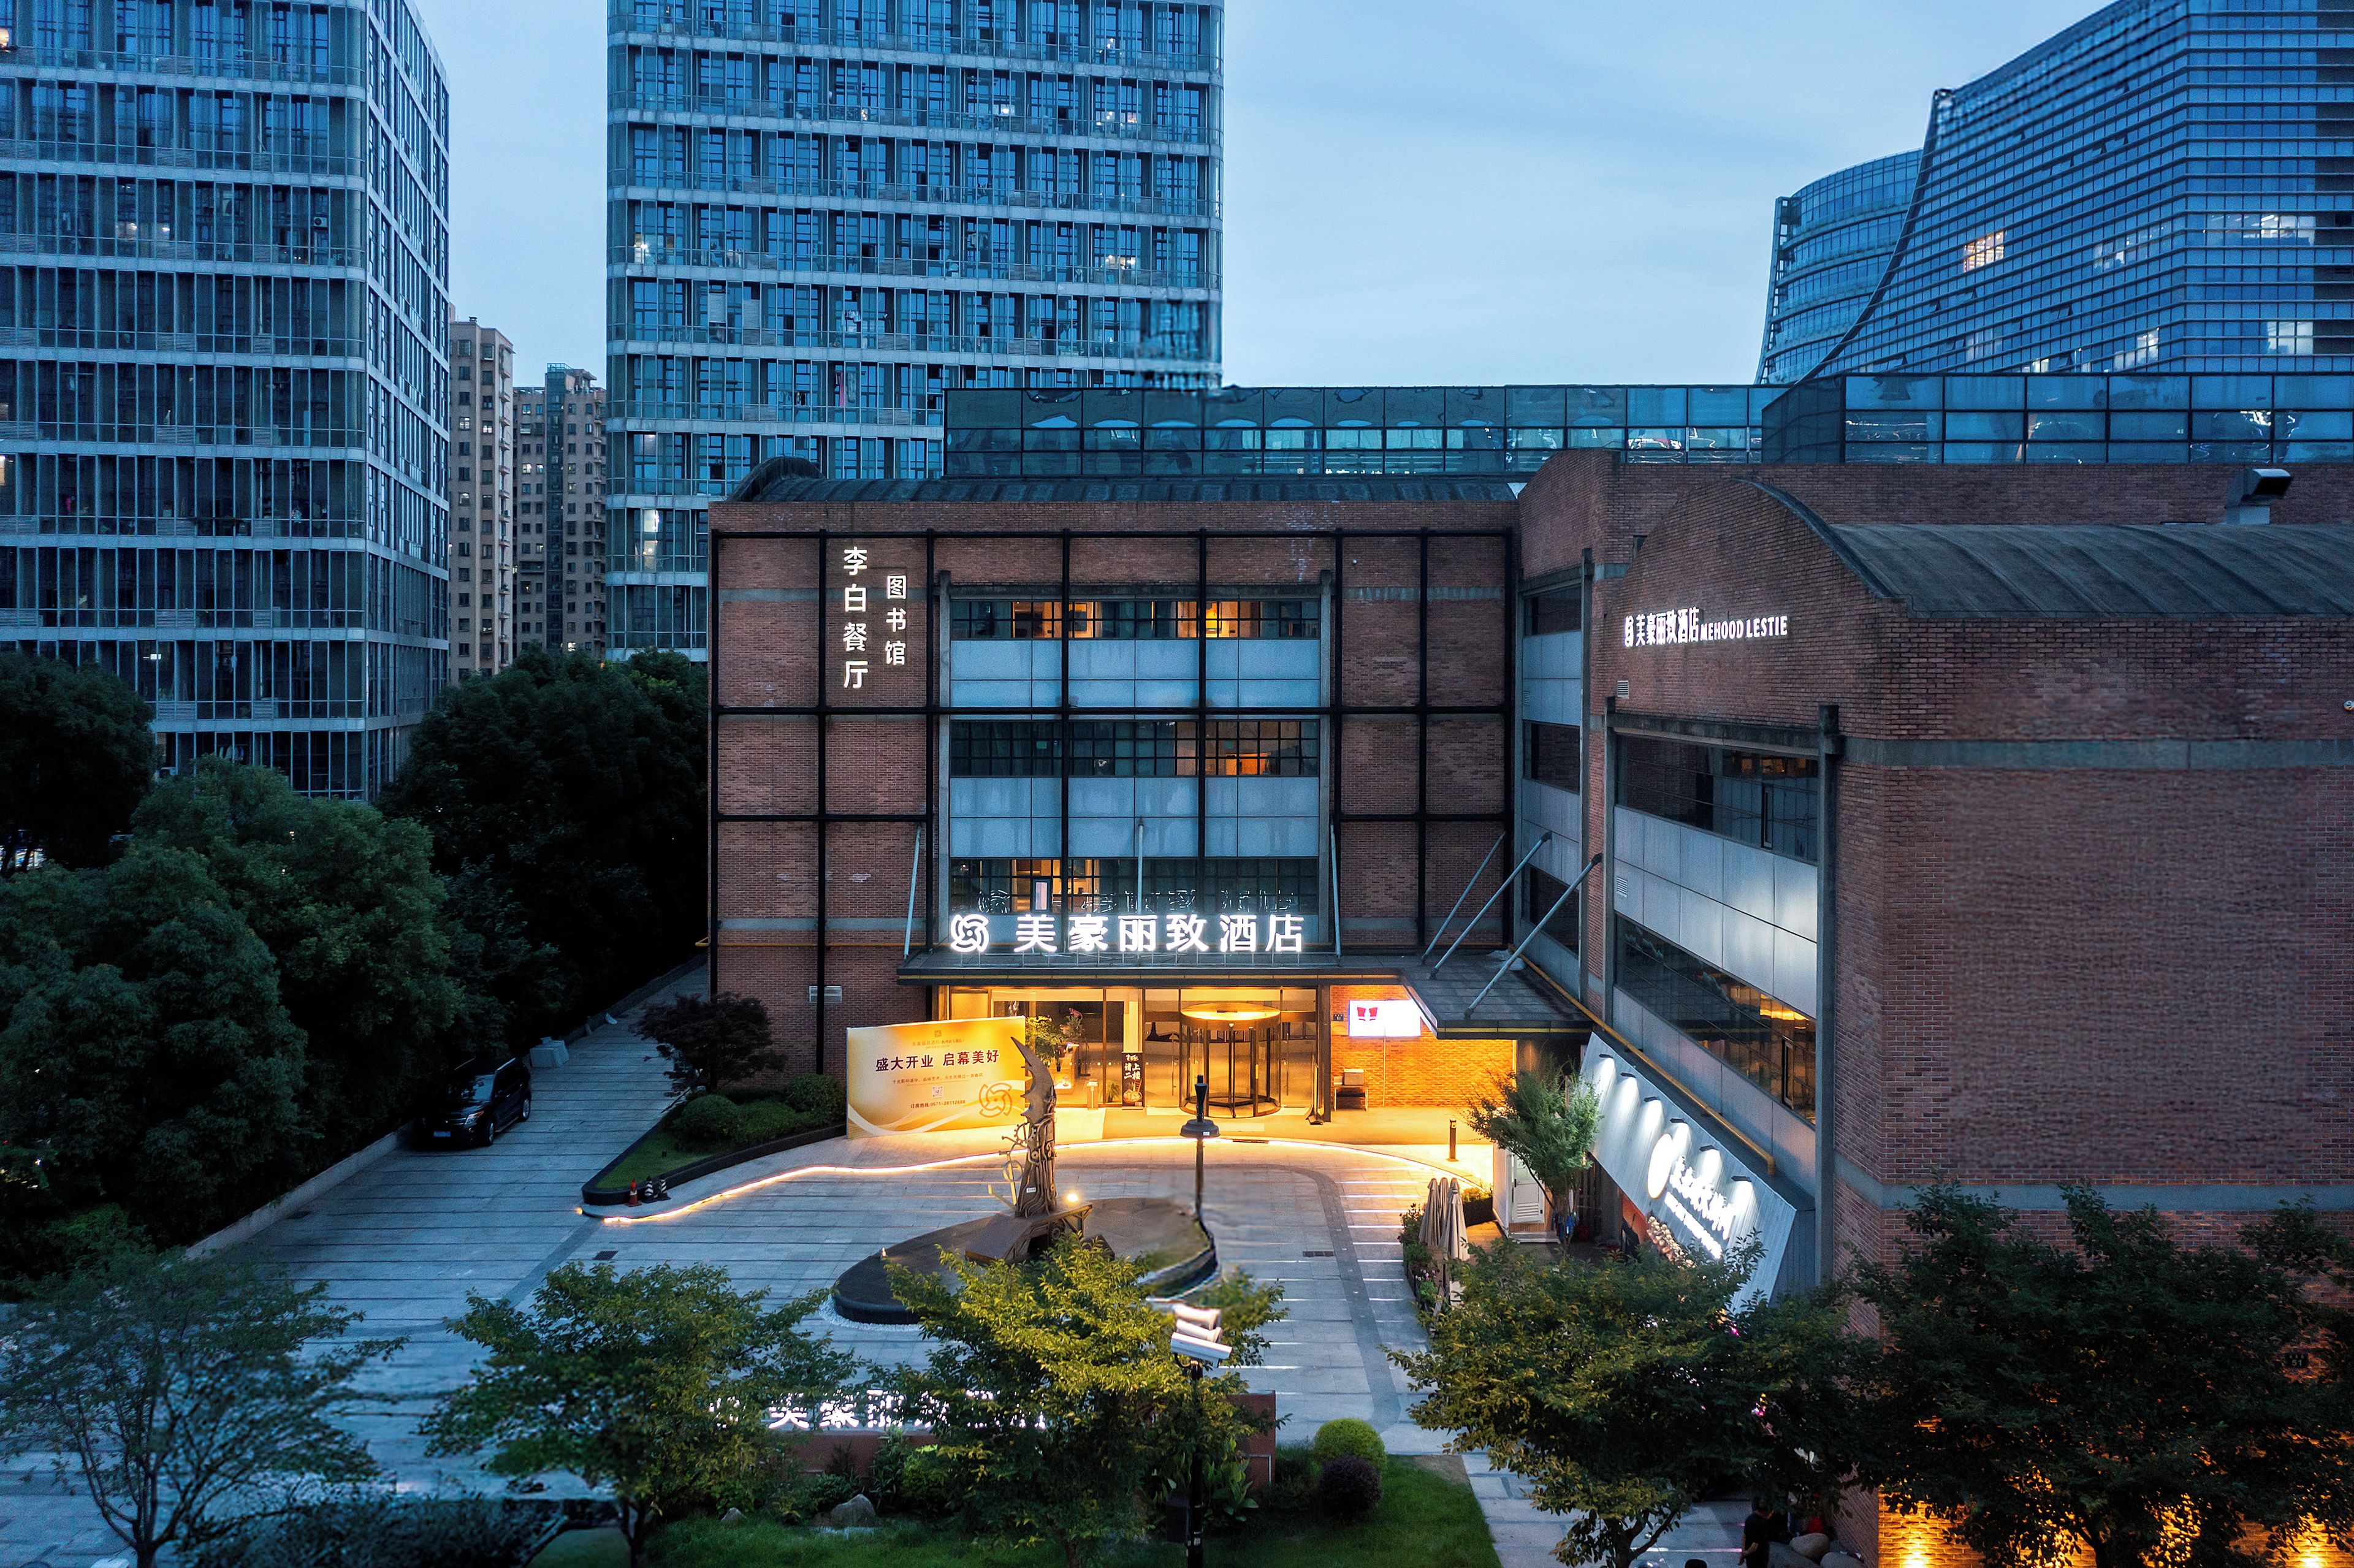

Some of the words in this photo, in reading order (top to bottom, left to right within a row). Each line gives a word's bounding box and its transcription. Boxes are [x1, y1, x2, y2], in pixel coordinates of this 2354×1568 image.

[843, 546, 869, 689] 李白餐厅
[885, 574, 907, 666] 图书馆
[1636, 606, 1700, 647] 美豪丽致酒店
[1700, 620, 1744, 641] MEHOOD
[1746, 615, 1788, 638] LESTIE
[1013, 914, 1305, 953] 美豪丽致酒店
[875, 1054, 934, 1072] 盛大开业
[942, 1049, 1000, 1067] 启幕美好
